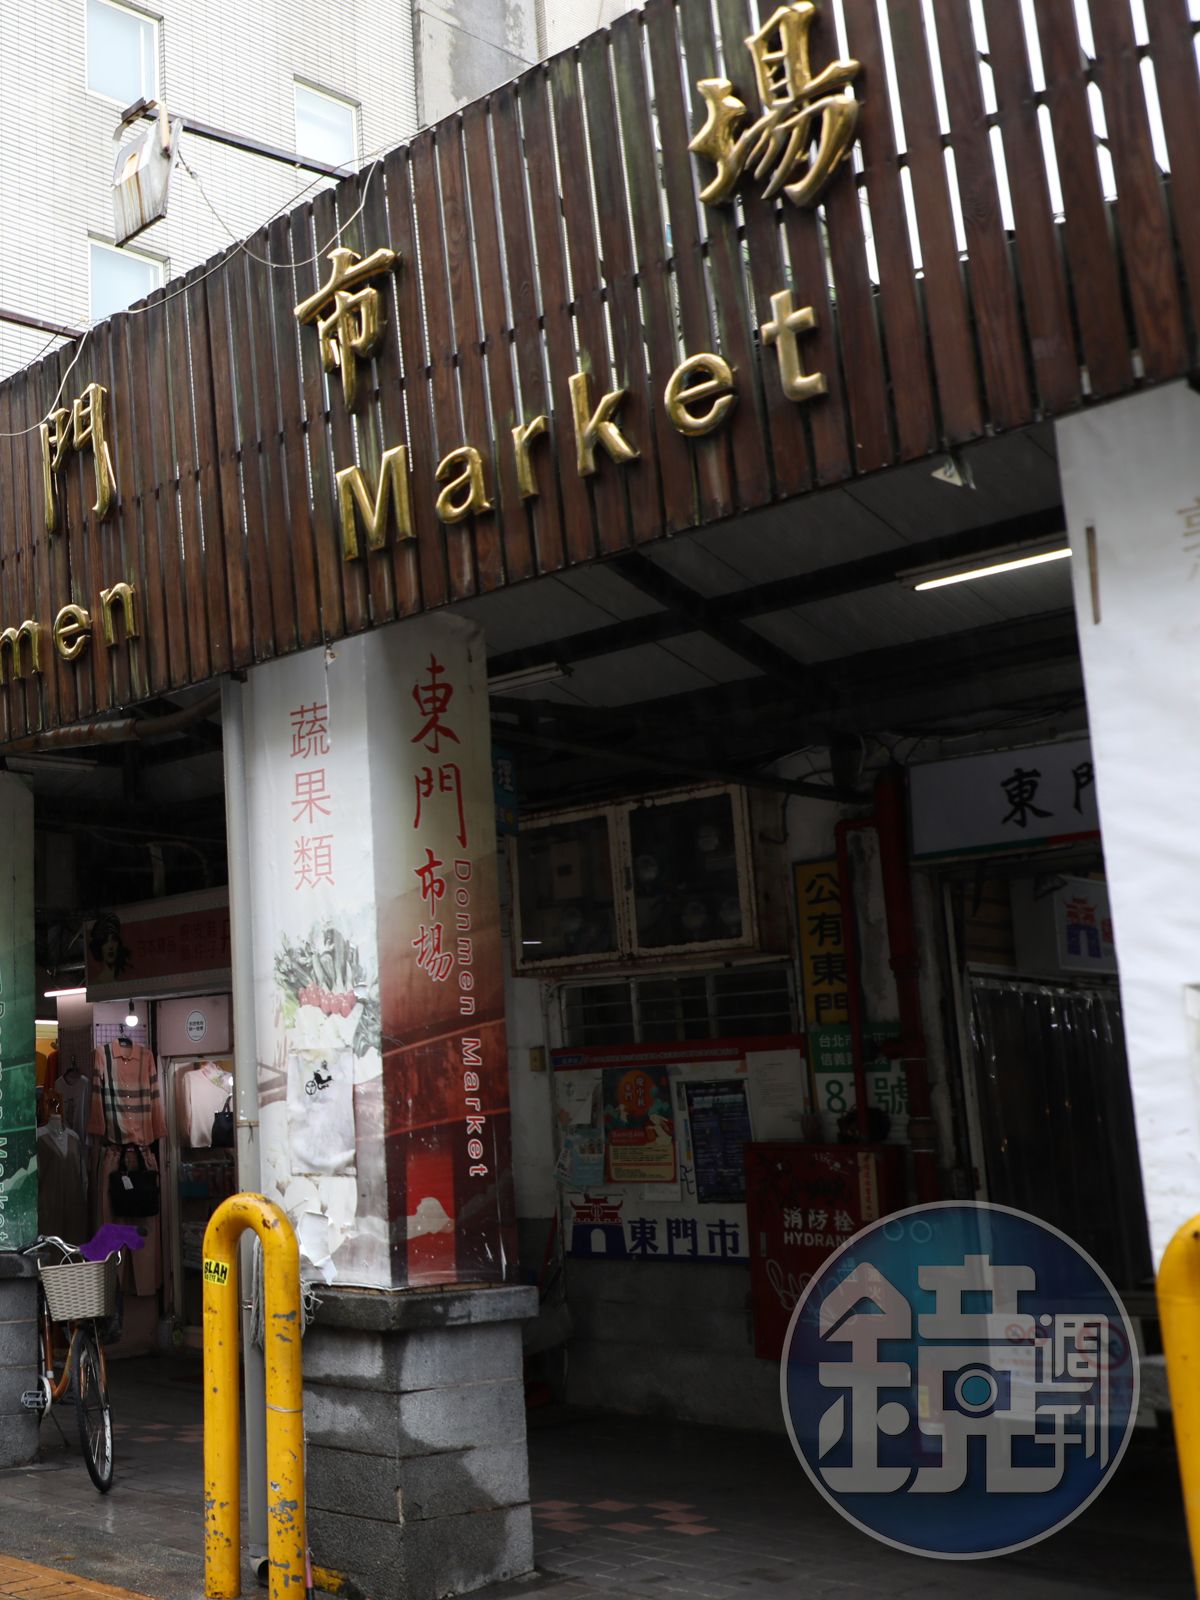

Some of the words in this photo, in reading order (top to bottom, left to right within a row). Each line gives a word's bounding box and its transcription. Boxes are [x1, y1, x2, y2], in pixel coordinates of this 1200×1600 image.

[335, 289, 829, 562] Market
[289, 701, 335, 891] 蔬果類
[411, 653, 467, 982] 東門市場
[453, 859, 477, 1015] Donmen
[461, 1037, 489, 1178] Market
[825, 1076, 912, 1115] 8號
[627, 1217, 740, 1257] 東門市
[783, 1207, 854, 1232] 消防栓
[784, 1231, 852, 1248] HYDRAN
